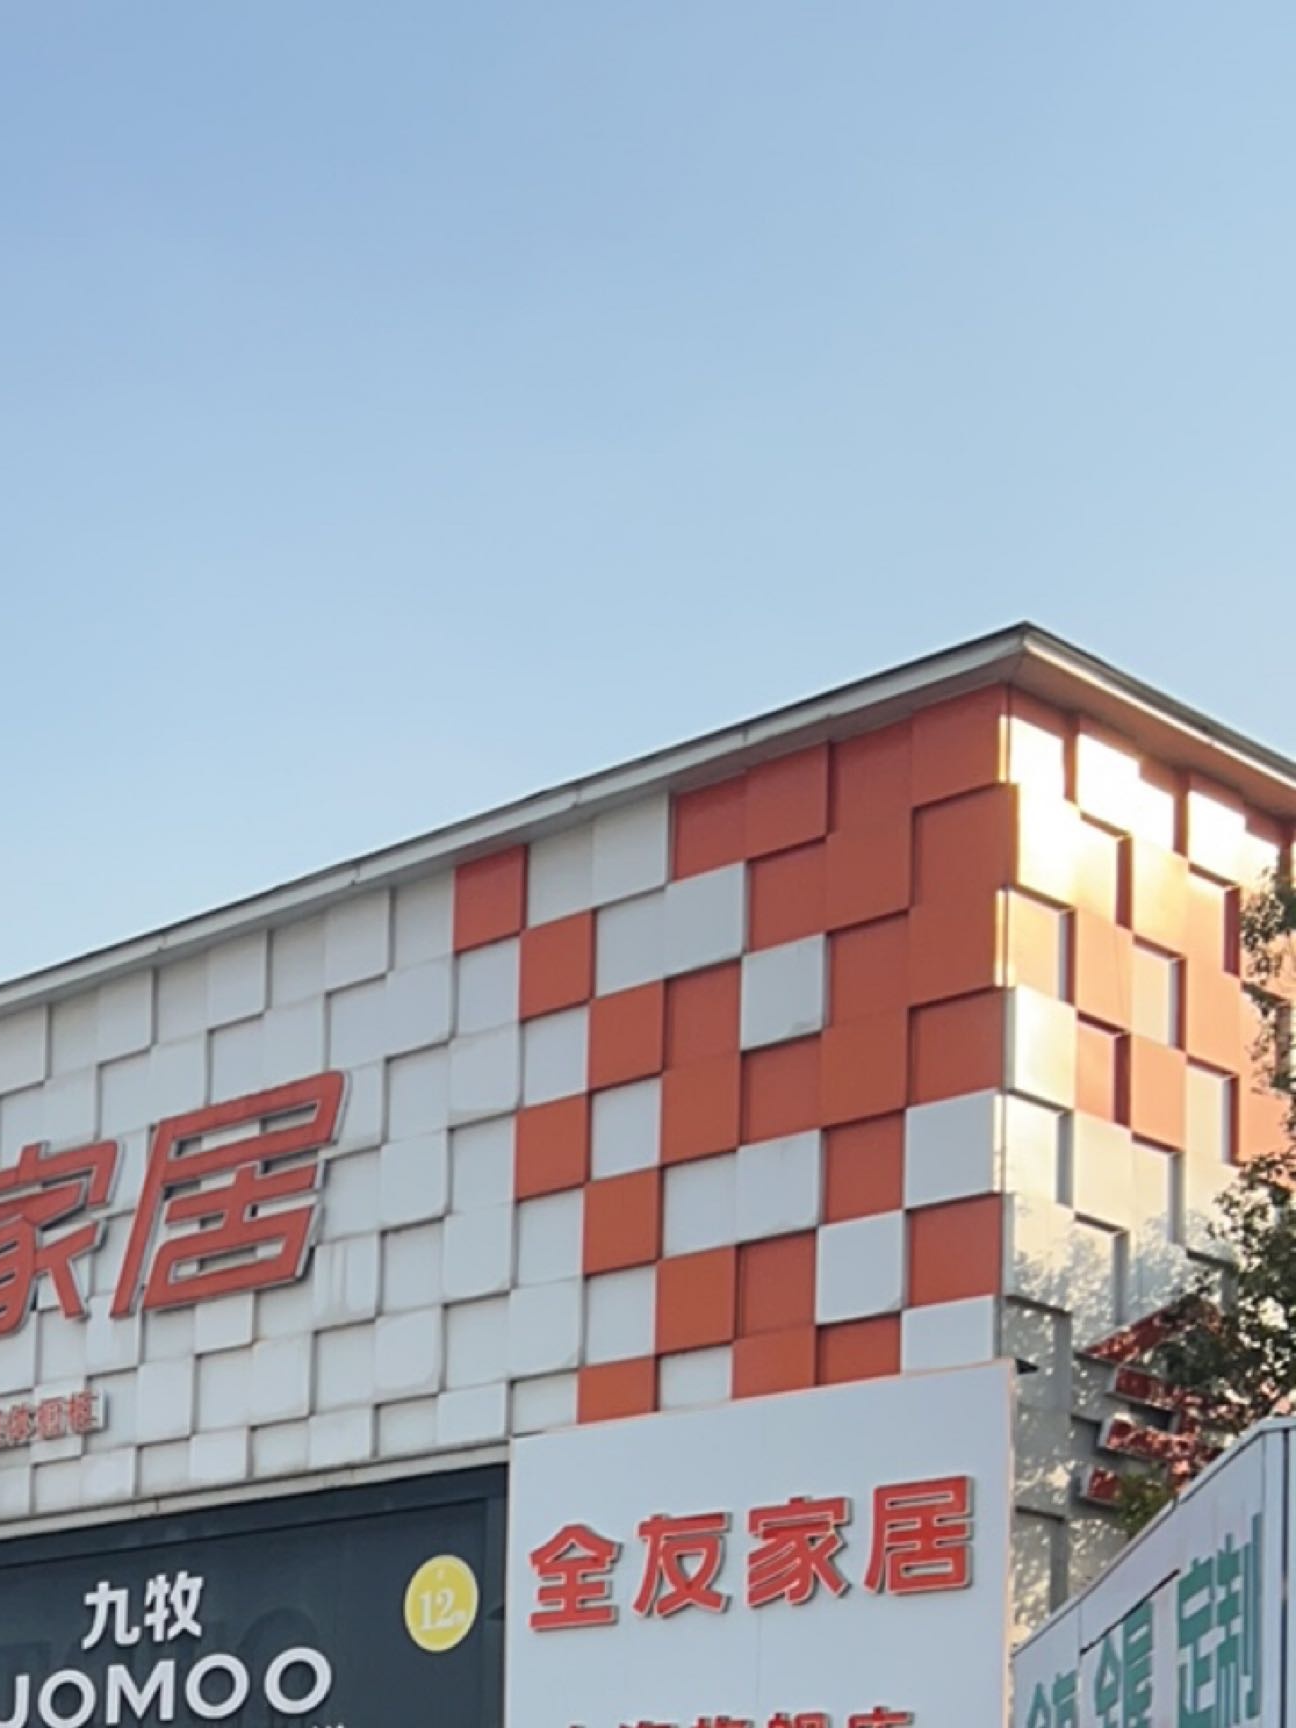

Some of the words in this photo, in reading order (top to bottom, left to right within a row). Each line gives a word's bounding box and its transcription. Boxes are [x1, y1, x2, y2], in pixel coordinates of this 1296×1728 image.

[81, 1570, 204, 1650] 九牧
[528, 1475, 975, 1633] 全友家居
